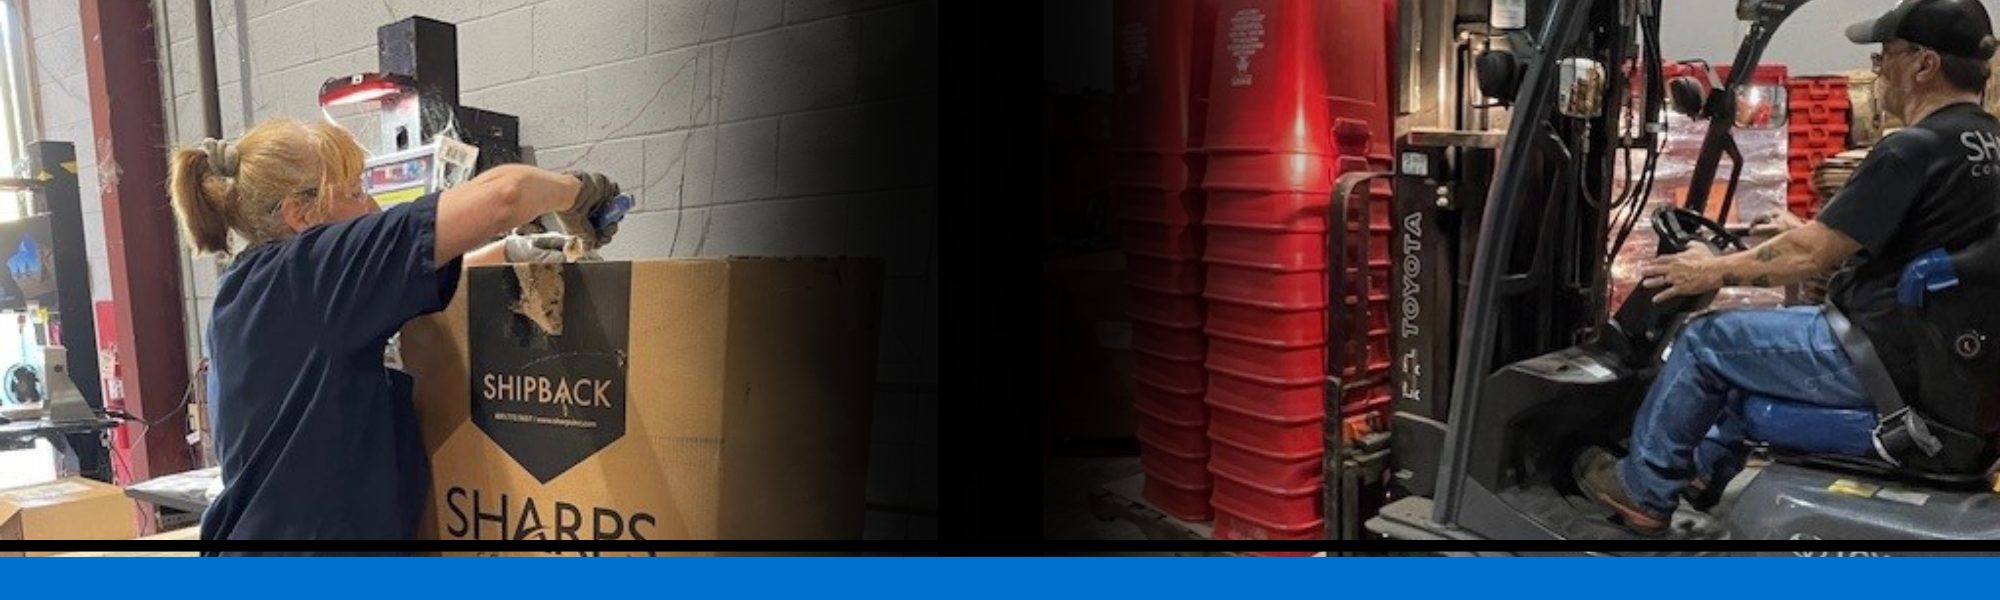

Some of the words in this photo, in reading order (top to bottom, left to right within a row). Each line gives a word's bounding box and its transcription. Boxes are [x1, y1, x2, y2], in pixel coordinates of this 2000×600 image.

[1402, 211, 1423, 338] TOYOTA
[483, 373, 612, 408] SHIPBACK
[446, 486, 656, 557] SHARPS
